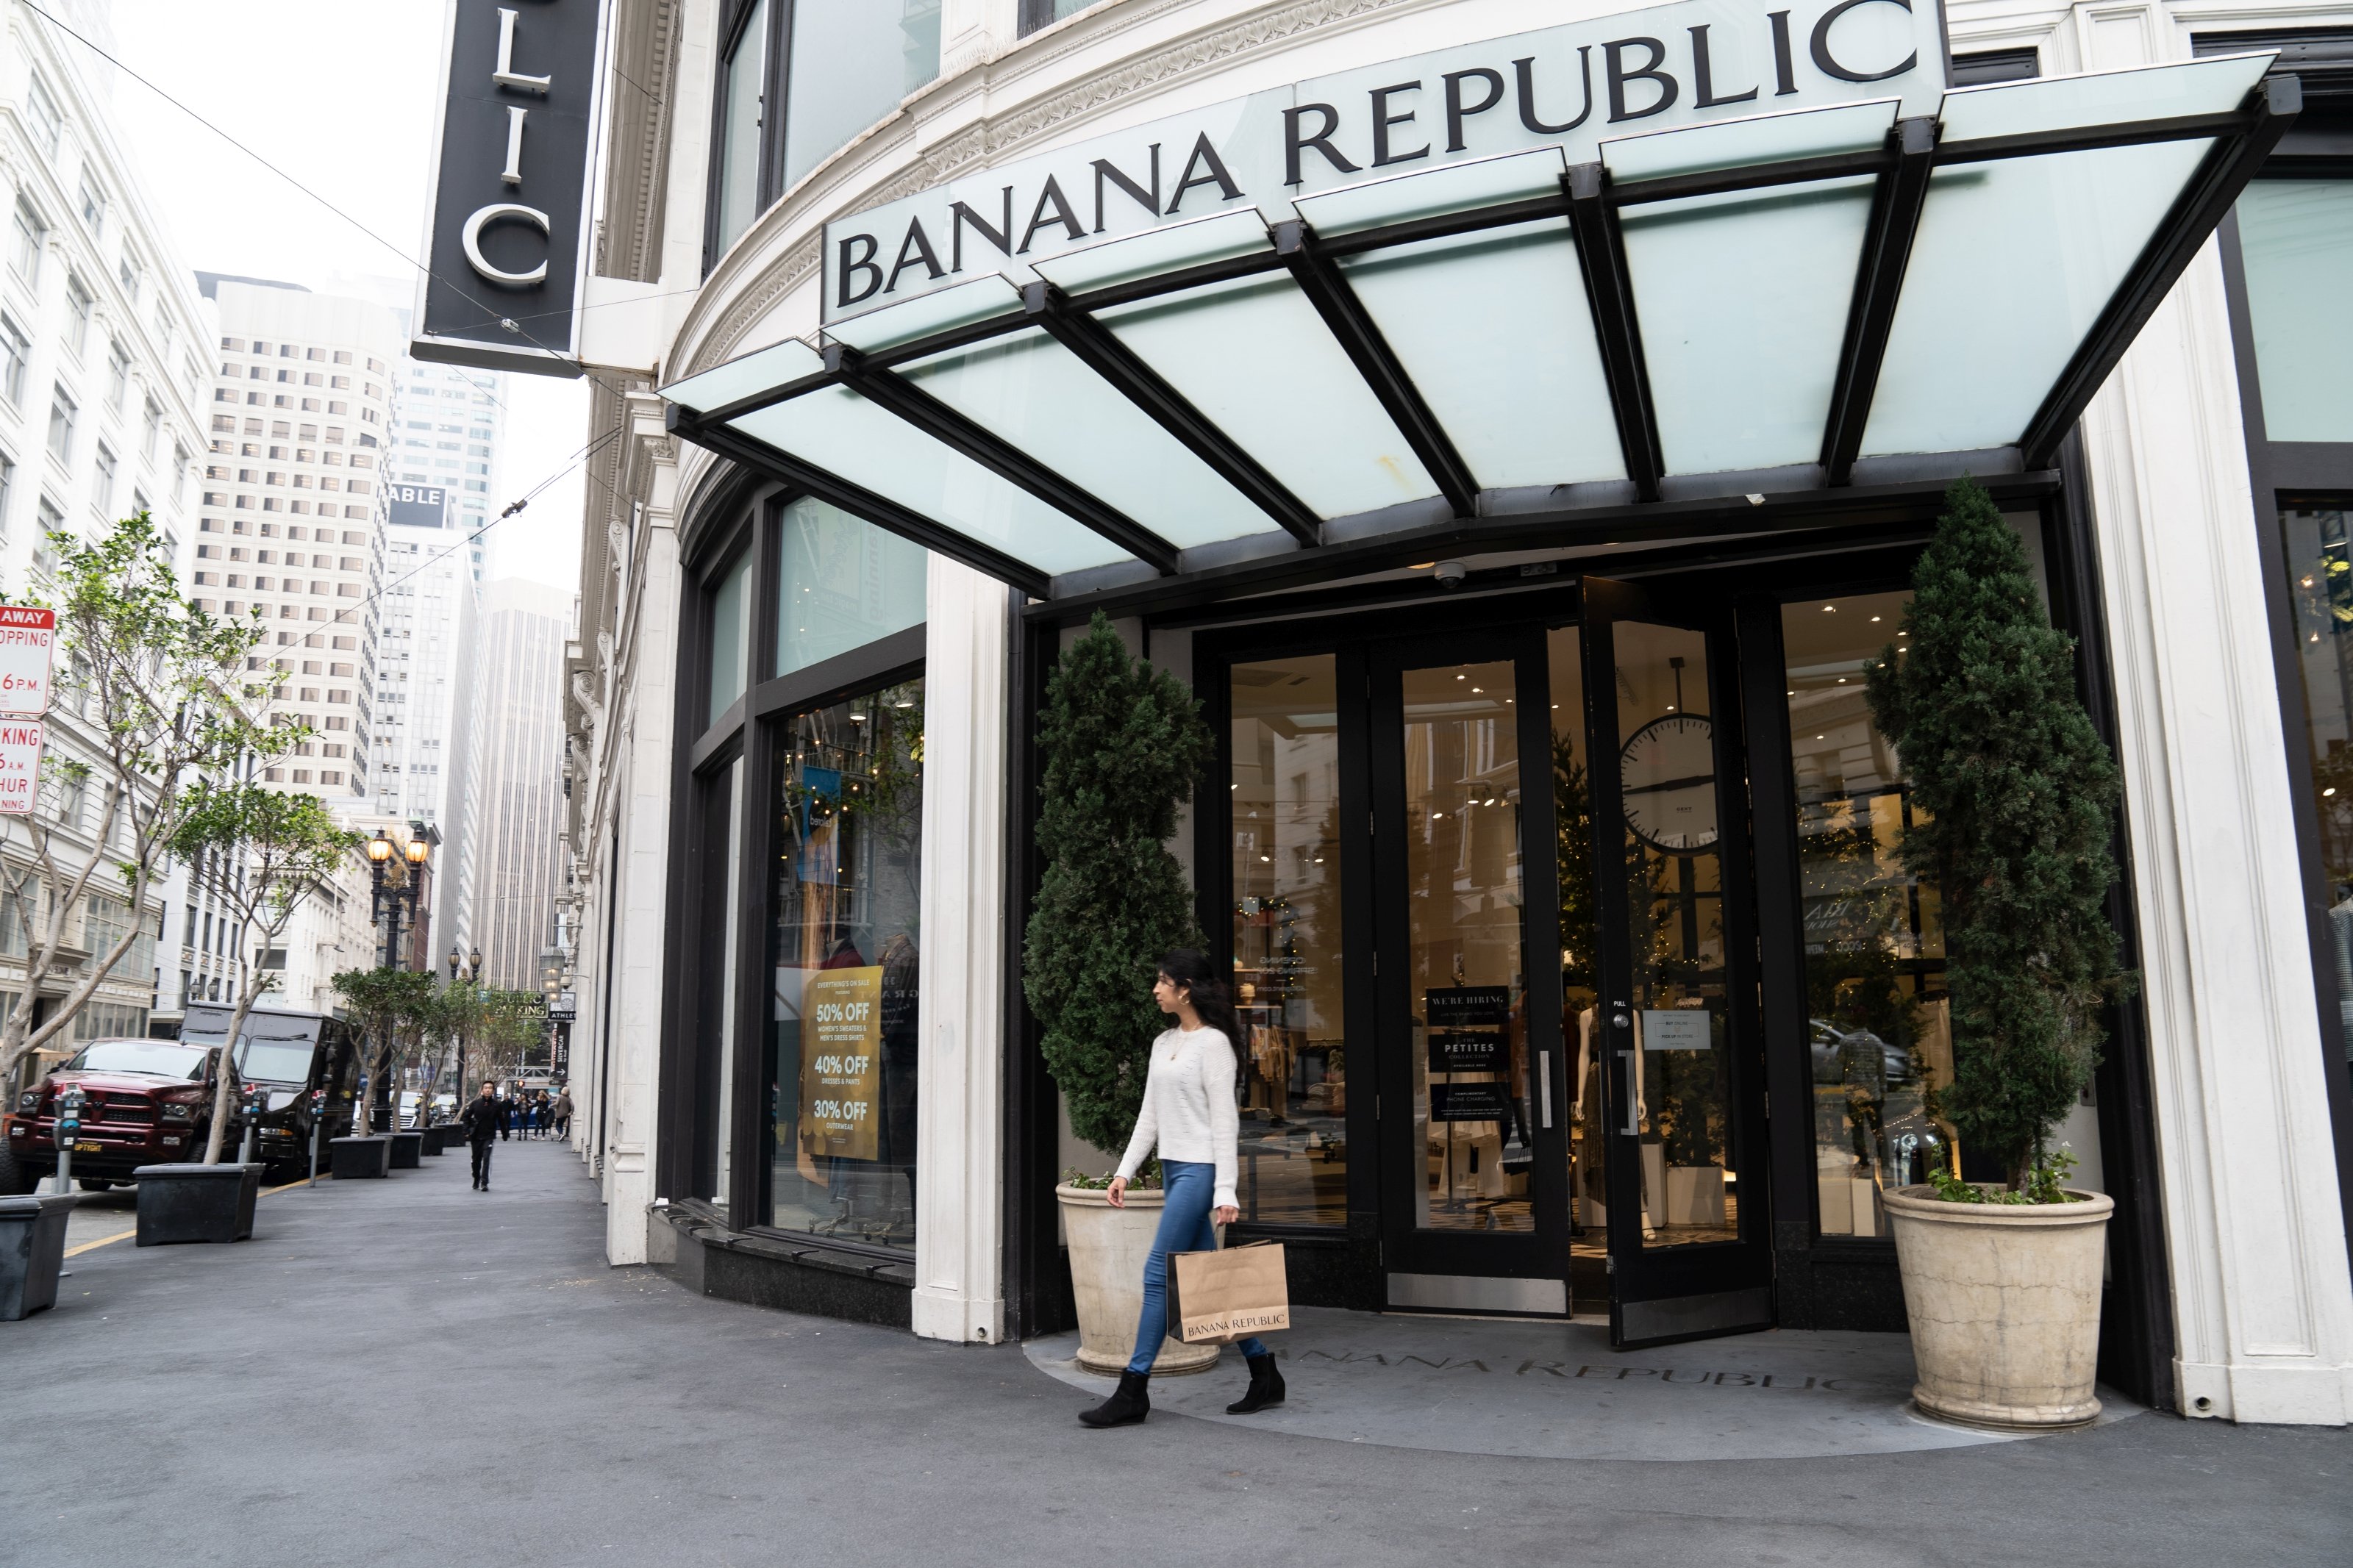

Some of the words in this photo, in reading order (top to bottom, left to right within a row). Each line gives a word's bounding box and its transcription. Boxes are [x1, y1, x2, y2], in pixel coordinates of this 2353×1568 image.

[837, 130, 1246, 309] BANANA
[1283, 0, 1918, 186] REPUBLIC
[390, 486, 440, 505] ABLE
[1, 610, 46, 624] AWAY
[3, 673, 13, 690] 6
[16, 679, 40, 691] P.M.
[8, 762, 26, 770] A.M.
[817, 980, 849, 989] EVERYTHING'S
[857, 978, 870, 987] SALE
[1432, 997, 1464, 1005] WE'RE
[1466, 995, 1504, 1005] HIRING
[816, 1003, 843, 1023] 50%
[845, 1002, 870, 1022] OFF
[1444, 1044, 1494, 1053] PETITES
[814, 1056, 842, 1074] 40%
[844, 1056, 869, 1075] OFF
[846, 1078, 860, 1086] PANTS
[814, 1100, 840, 1119] 30%
[843, 1100, 868, 1120] OFF
[826, 1122, 854, 1131] OUTERWEAR
[1188, 1320, 1229, 1337] BANANA
[1232, 1314, 1285, 1328] REPUBLIC
[1277, 1350, 1491, 1373] NANA
[1515, 1359, 1877, 1392] REPUBLIC
